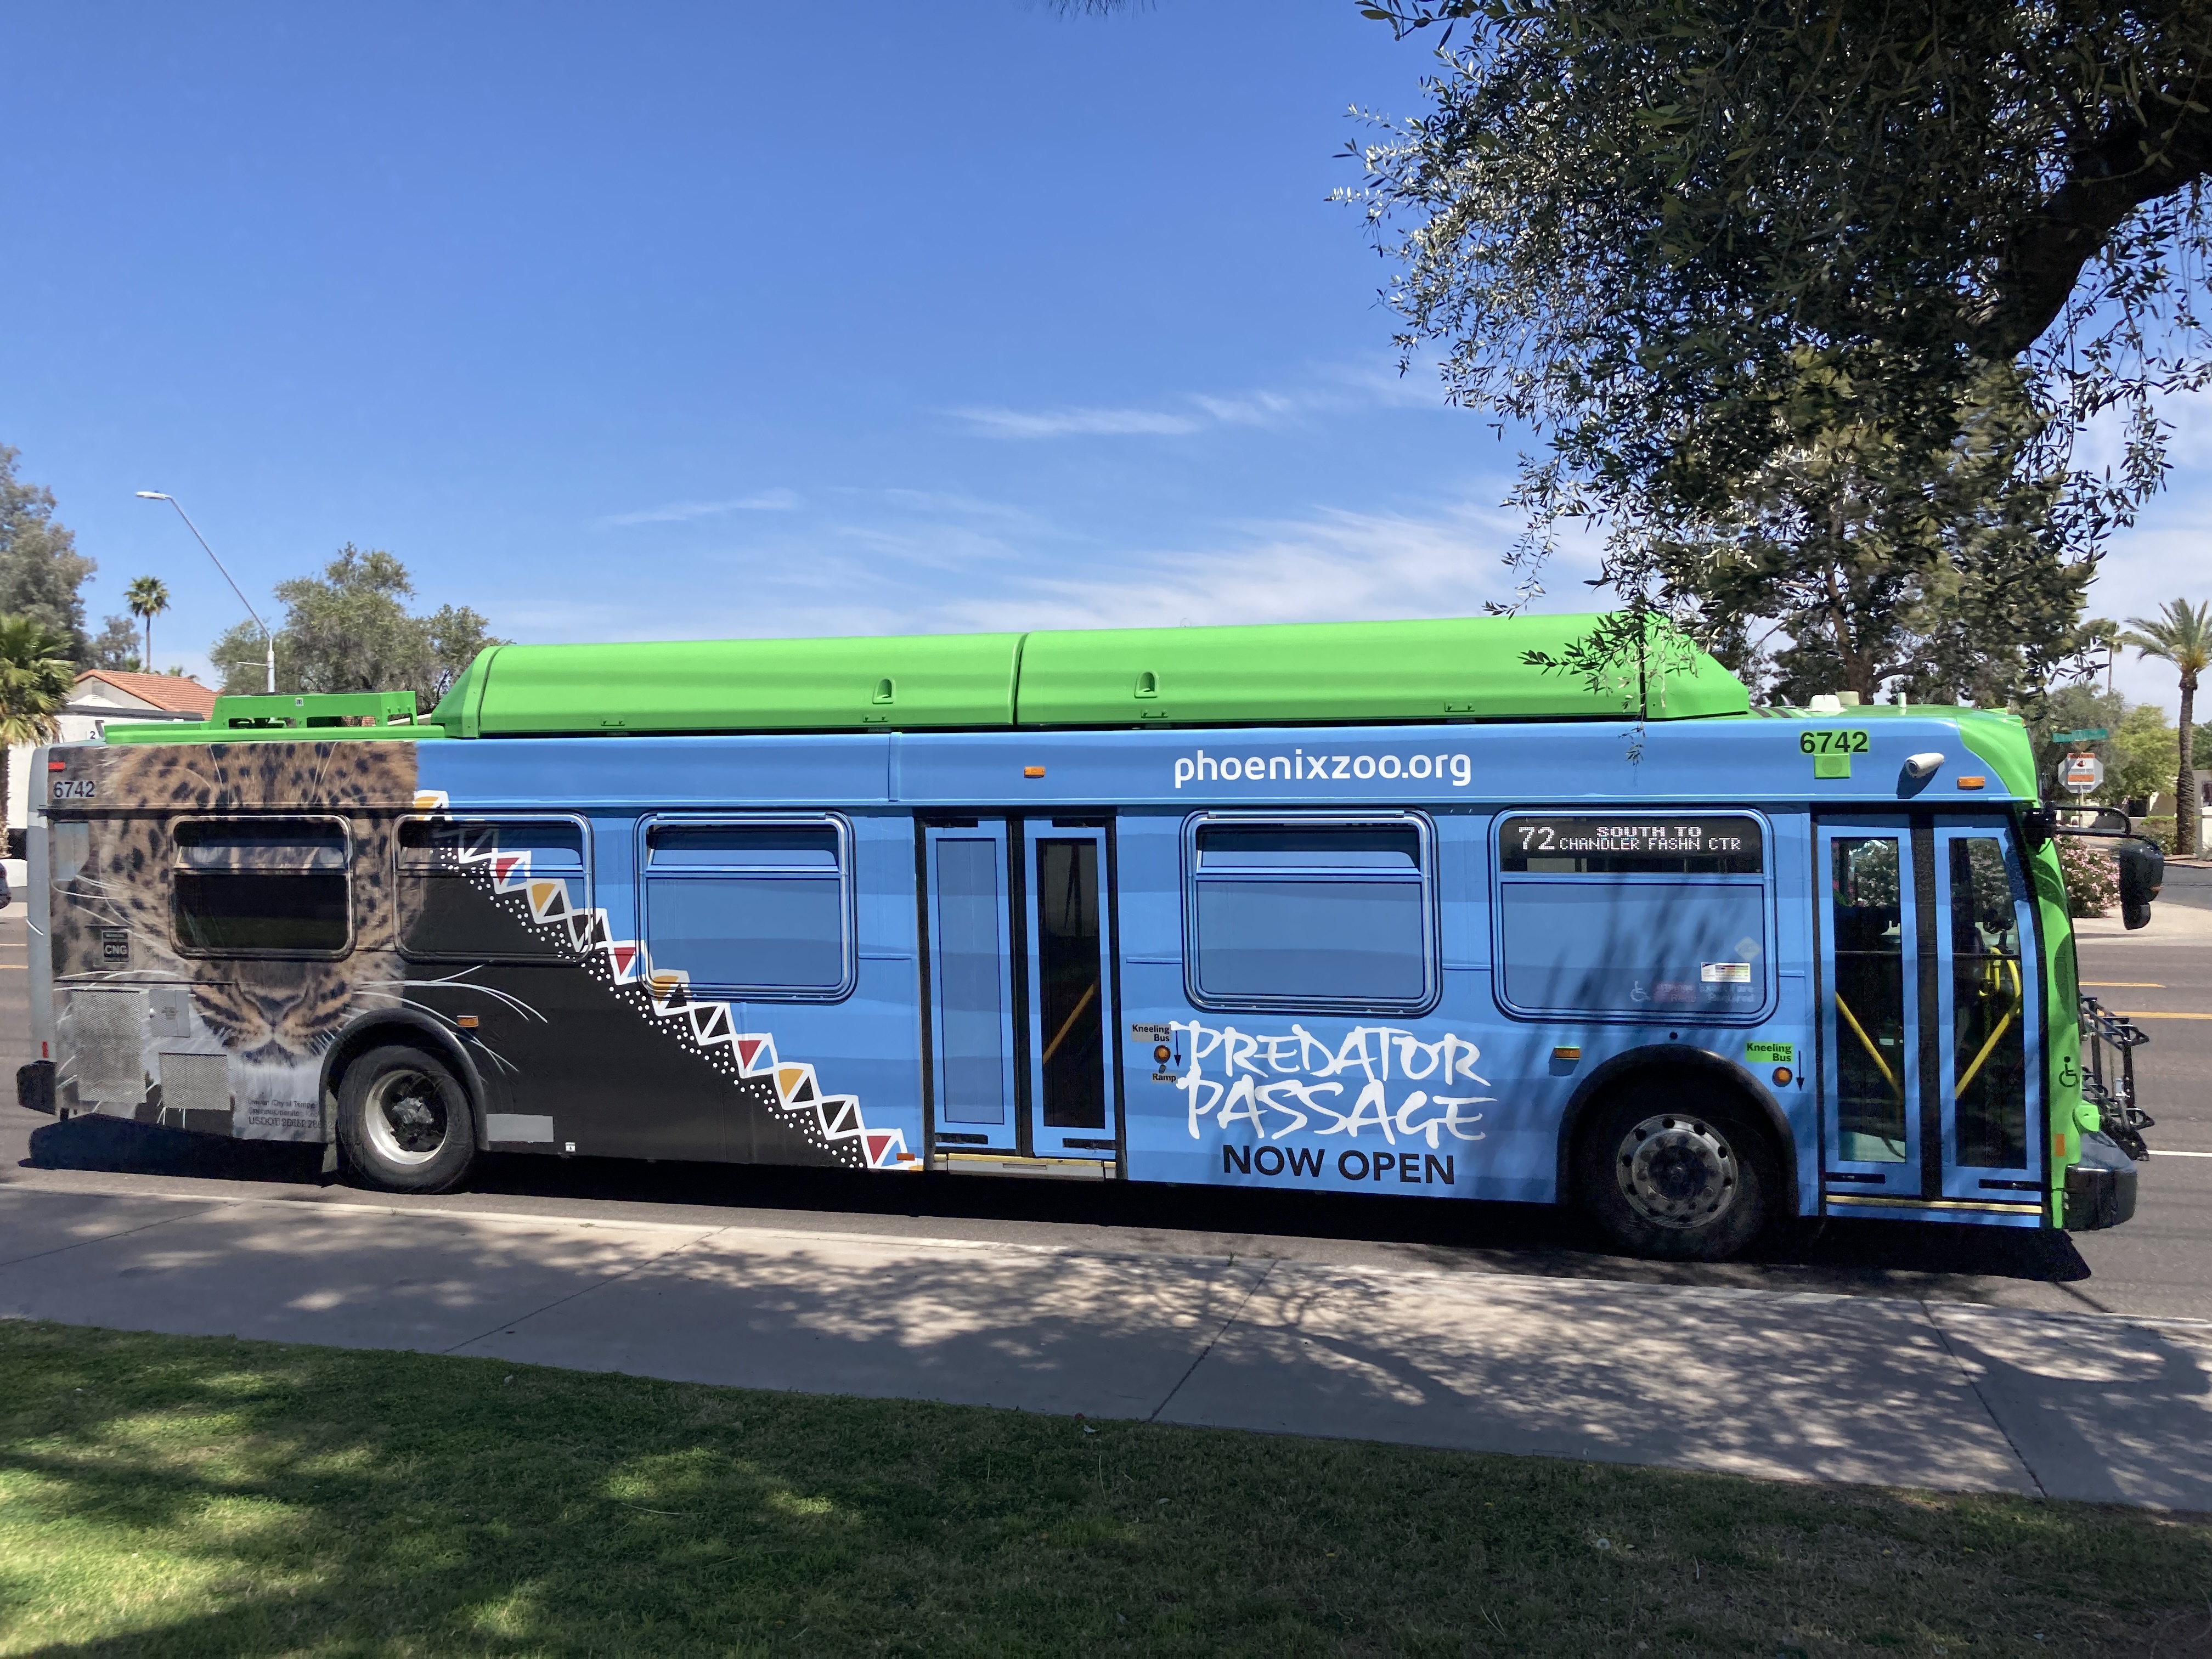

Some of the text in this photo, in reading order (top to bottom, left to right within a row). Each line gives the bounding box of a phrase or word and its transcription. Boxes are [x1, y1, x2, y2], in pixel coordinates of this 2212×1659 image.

[1800, 731, 1868, 753] 6742
[1175, 749, 1471, 788] phoenixzoo.org
[53, 781, 95, 798] 6742
[1518, 826, 1555, 850] 72
[1596, 826, 1702, 837] SOUTH TO
[1559, 837, 1742, 850] CHANDLER FASHN CTR
[105, 945, 127, 955] CNG
[1132, 1024, 1170, 1035] Kneeling
[1169, 1020, 1491, 1086] PREDATOR
[1747, 1043, 1792, 1054] Kneeling
[1773, 1053, 1792, 1062] Bus
[1152, 1073, 1177, 1083] Ramp
[1176, 1070, 1498, 1149] PASSAGE
[1223, 1144, 1454, 1185] NOW OPEN
